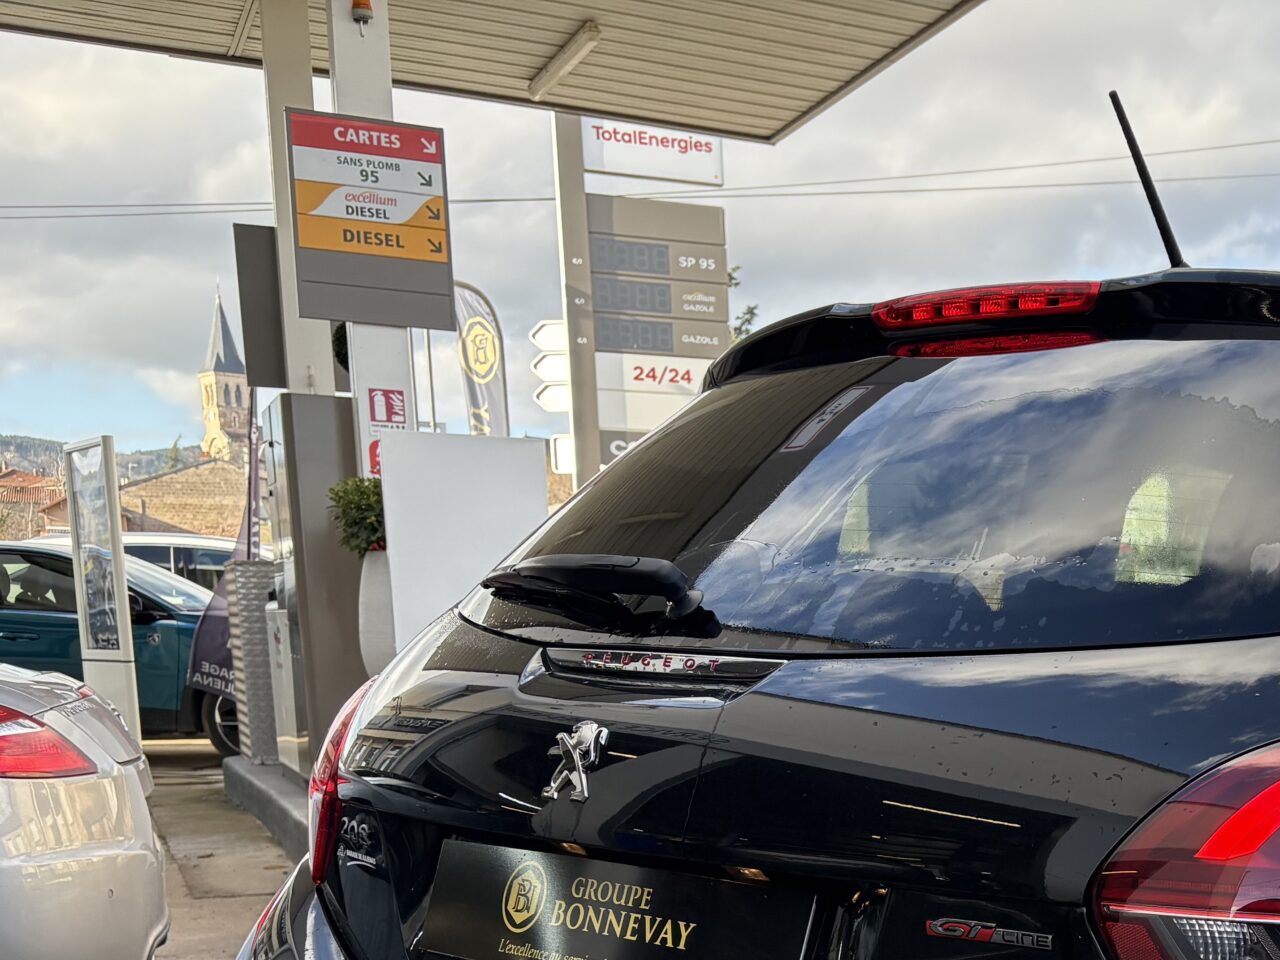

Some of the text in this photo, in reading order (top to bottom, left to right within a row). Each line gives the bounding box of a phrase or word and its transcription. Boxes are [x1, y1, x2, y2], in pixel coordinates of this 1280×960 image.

[333, 127, 401, 148] CARTES
[592, 125, 713, 154] TotalEnergies
[336, 155, 401, 171] SANS PLOMB
[360, 169, 379, 183] 95
[345, 192, 397, 207] excellium
[345, 205, 390, 220] DIESEL
[343, 228, 405, 248] DIESEL
[678, 256, 716, 270] SP 95
[683, 304, 715, 313] GAZOLE
[681, 335, 719, 345] GAZOLE
[633, 366, 693, 385] 24/24
[584, 652, 719, 672] PEUGEOT
[341, 816, 369, 845] 208
[571, 877, 653, 910] GROUPE
[551, 900, 697, 950] BONNEVAY
[930, 918, 1051, 949] GT LINE
[498, 938, 551, 960] L'excellence
